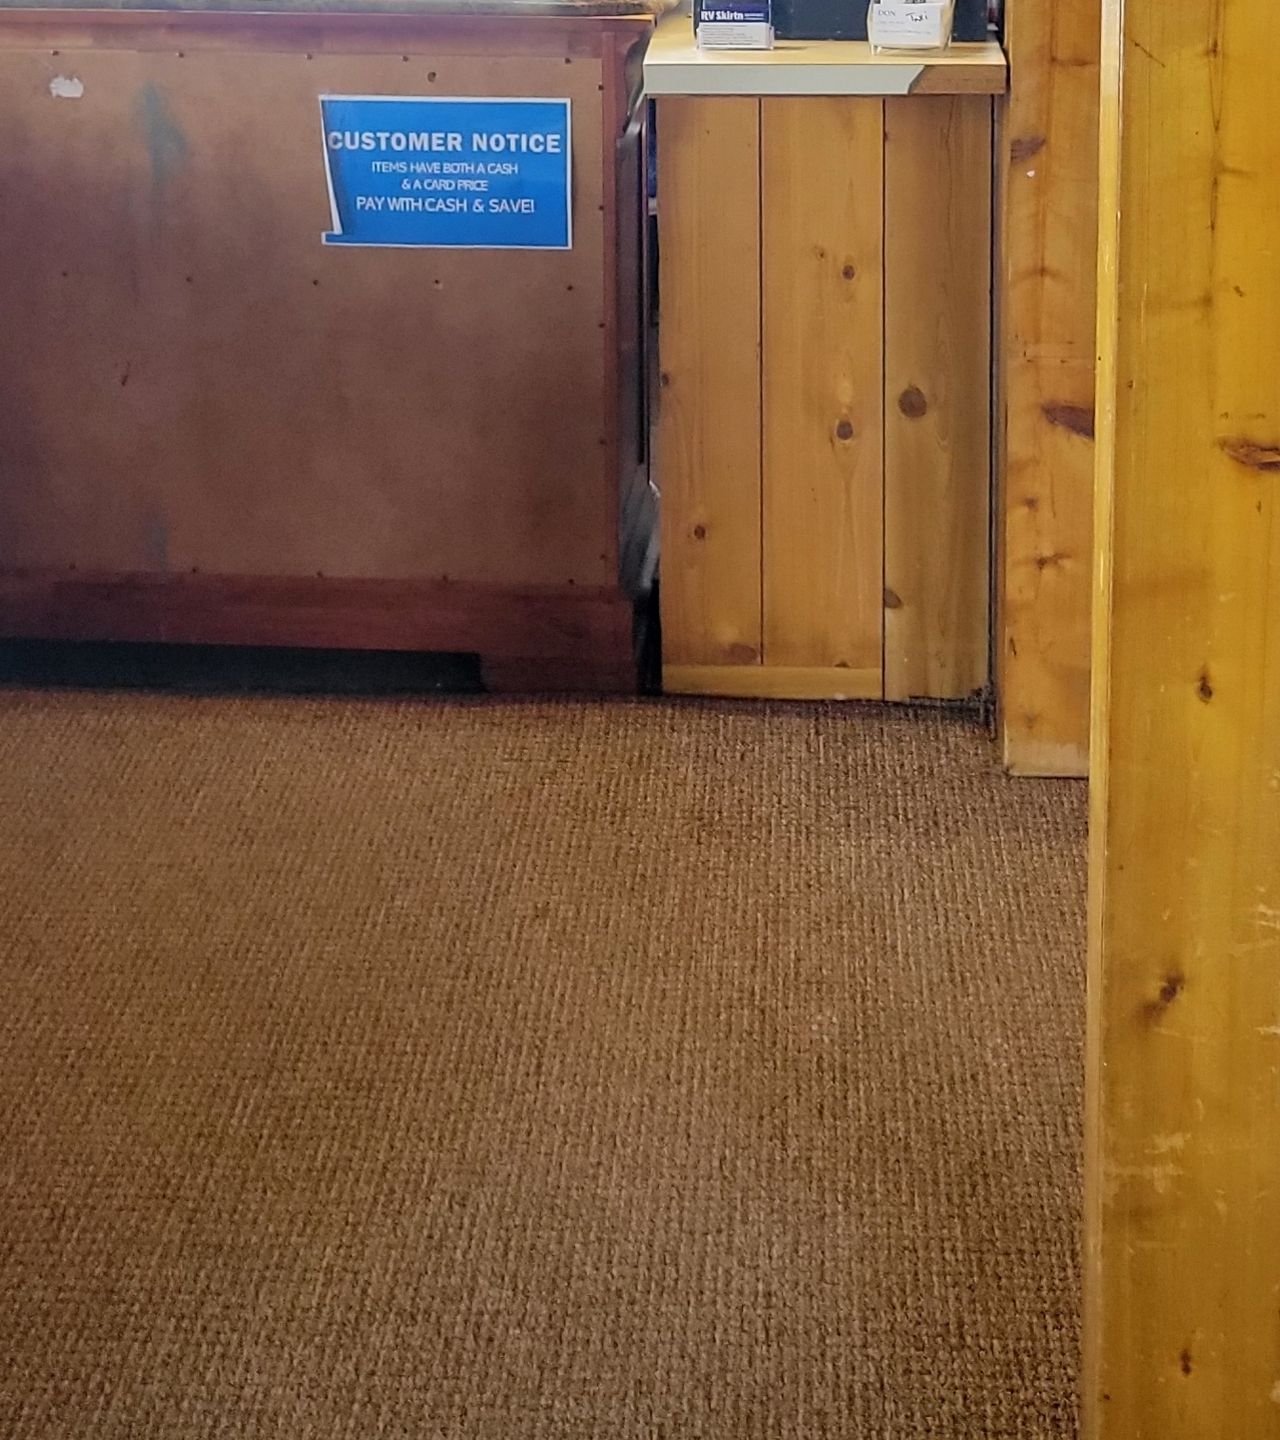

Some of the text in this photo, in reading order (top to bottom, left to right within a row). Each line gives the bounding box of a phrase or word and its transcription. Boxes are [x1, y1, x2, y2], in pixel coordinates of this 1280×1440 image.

[701, 10, 715, 21] RV
[328, 131, 561, 153] CUSTOMER NOTICE
[372, 161, 519, 175] ITEMS HAVE BOTH A CASH
[401, 179, 489, 191] & A CARD PRICE
[356, 196, 535, 213] PAY WITH CASH & SAVE!
